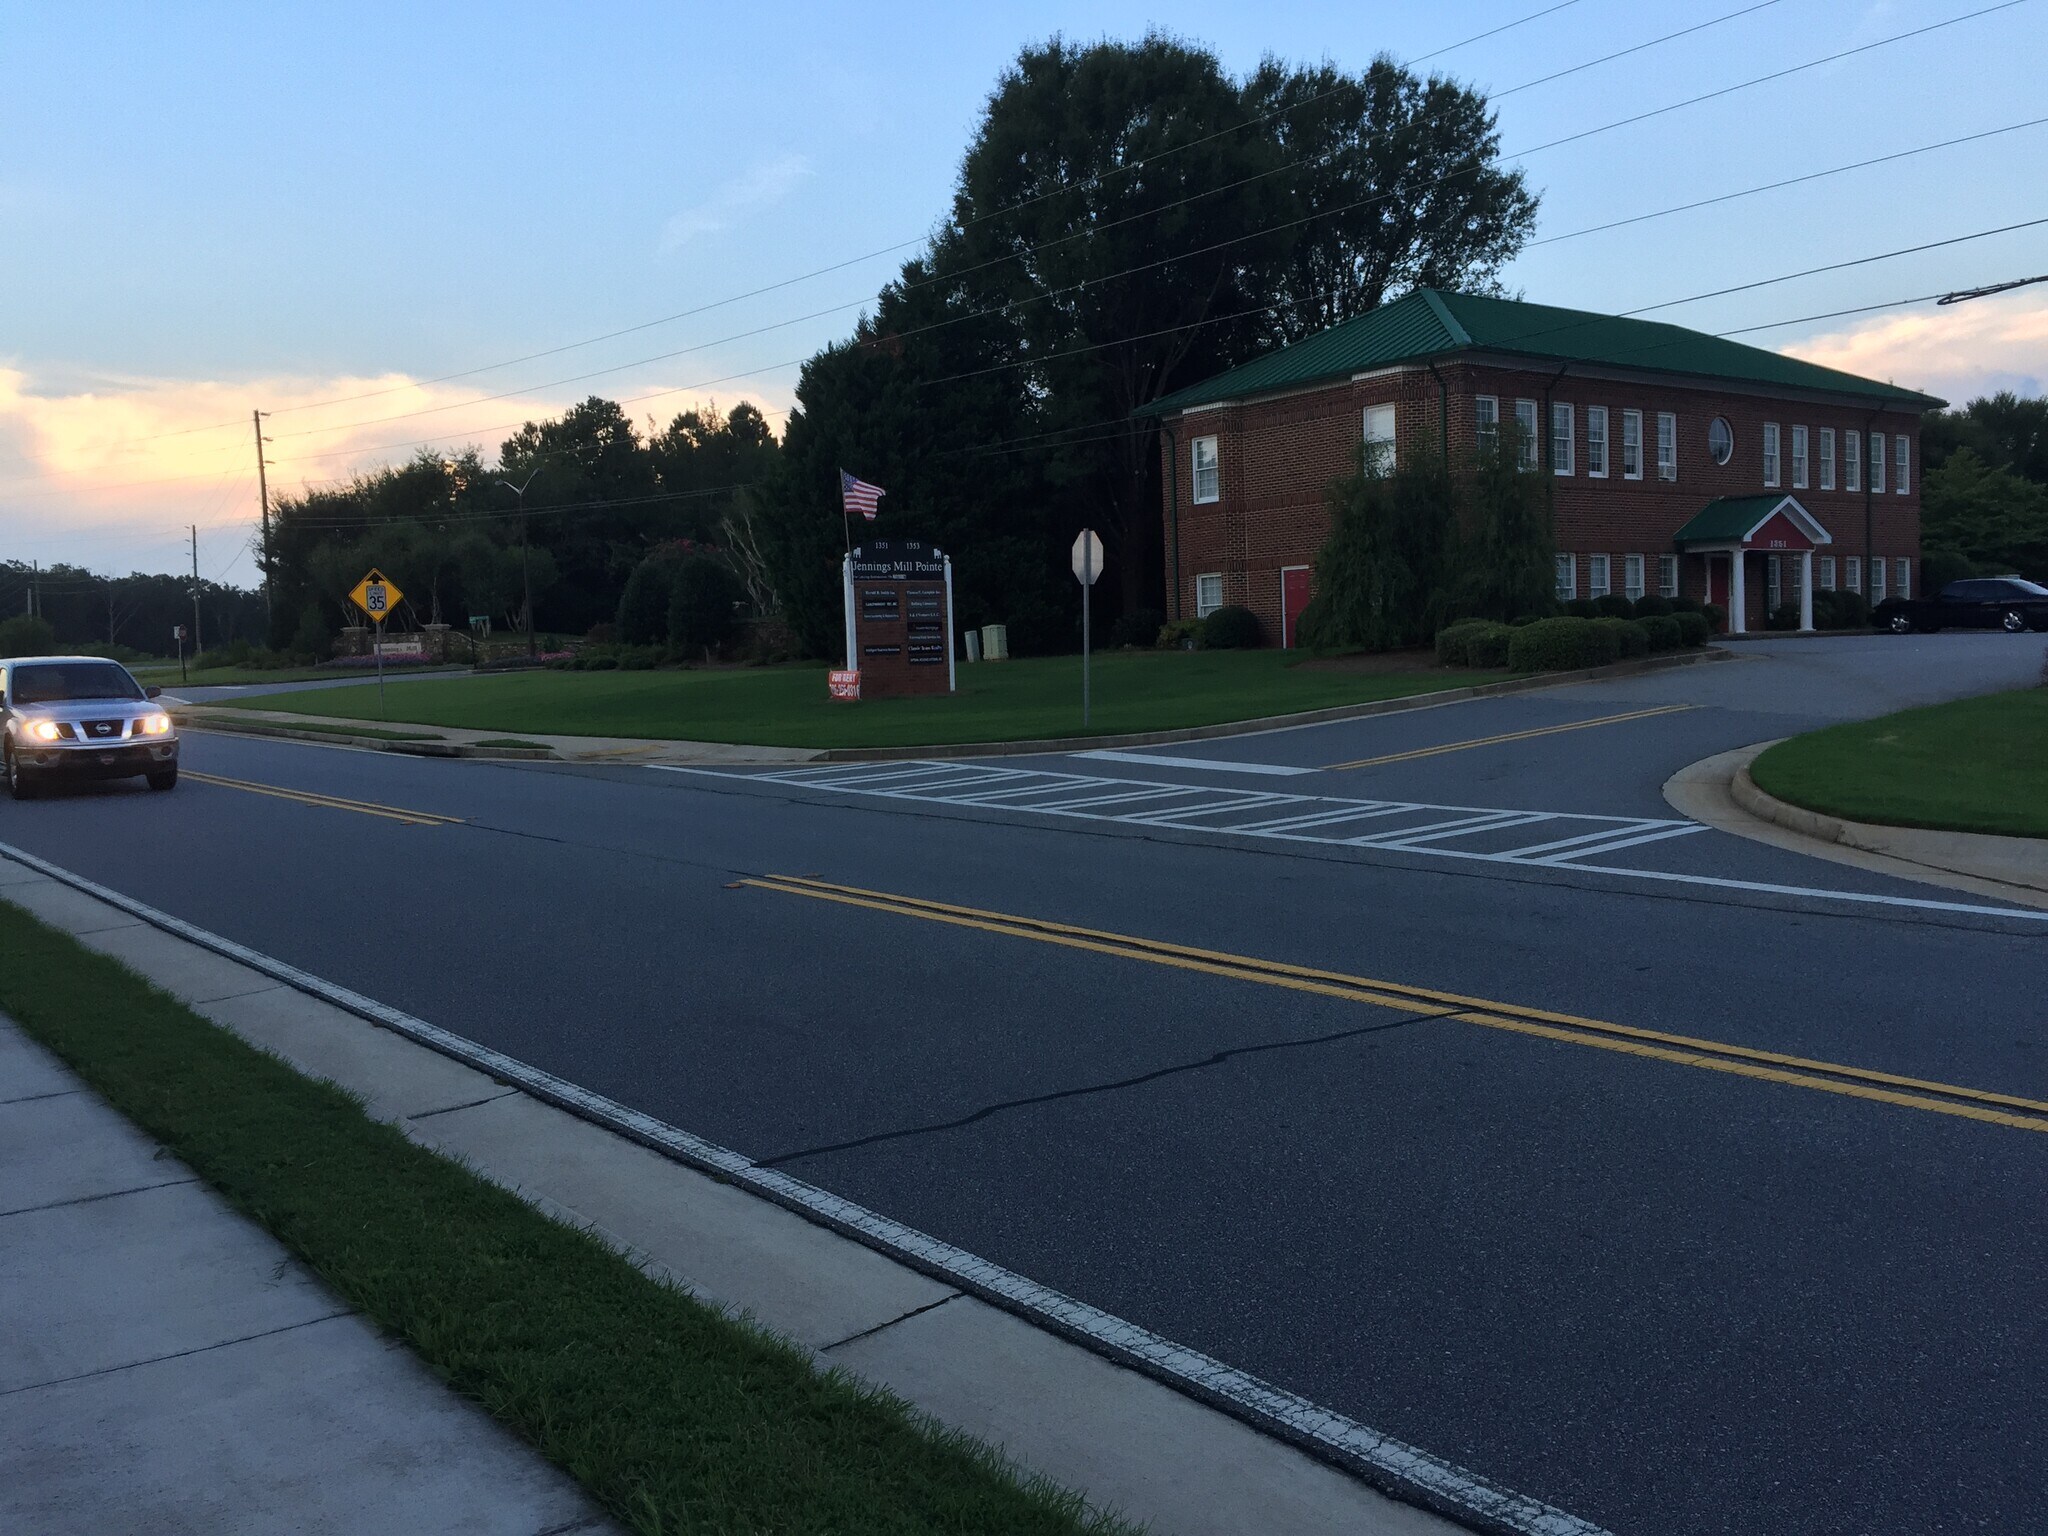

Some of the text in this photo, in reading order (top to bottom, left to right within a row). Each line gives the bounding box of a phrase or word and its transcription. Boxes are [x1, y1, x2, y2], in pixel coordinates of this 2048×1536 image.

[906, 542, 921, 550] 1353
[853, 561, 943, 574] Jennings Mill Pointe
[369, 595, 385, 610] 35
[831, 673, 856, 682] FOR RENT
